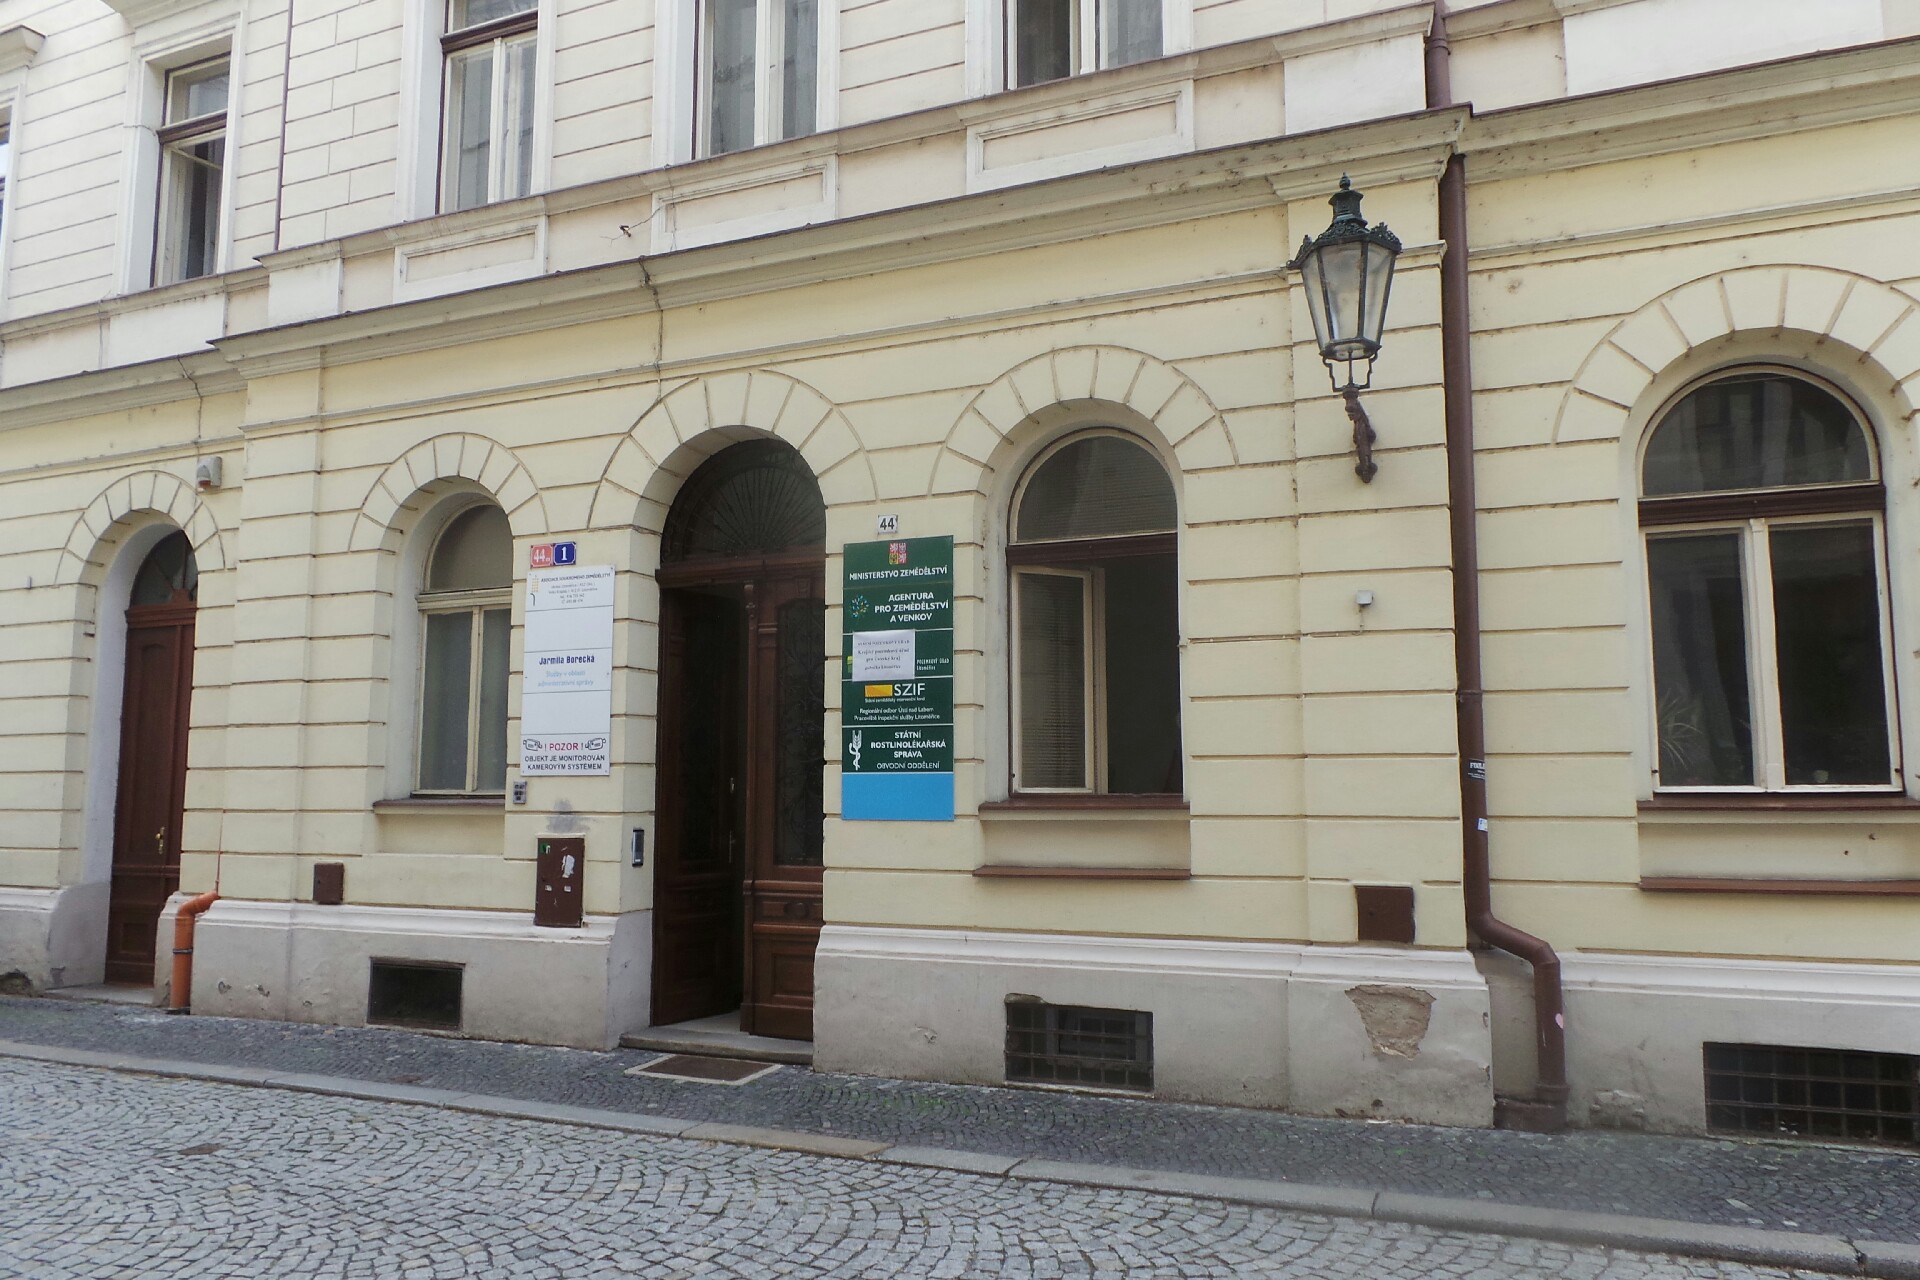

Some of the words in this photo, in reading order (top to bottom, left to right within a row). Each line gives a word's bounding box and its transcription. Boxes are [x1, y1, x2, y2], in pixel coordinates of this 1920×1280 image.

[880, 518, 895, 530] 44
[561, 546, 568, 561] 1
[850, 570, 898, 580] MINISTERSTVO
[900, 564, 948, 577] ZEMĚDĚLSTVÍ
[888, 592, 934, 602] AGENTURA
[874, 605, 892, 613] PRO
[893, 600, 948, 612] ZEMĚDĚLSTVÍ
[898, 613, 932, 622] VENKOV
[539, 656, 564, 665] Jarmila
[894, 683, 925, 696] SZIF
[894, 730, 922, 739] STÁTNÍ
[549, 742, 579, 751] POZOR
[871, 739, 946, 749] ROSTLINOLÉKAŘSKÁ
[894, 750, 922, 758] SPRÁVA
[907, 761, 940, 769] ODDĚLENÍ
